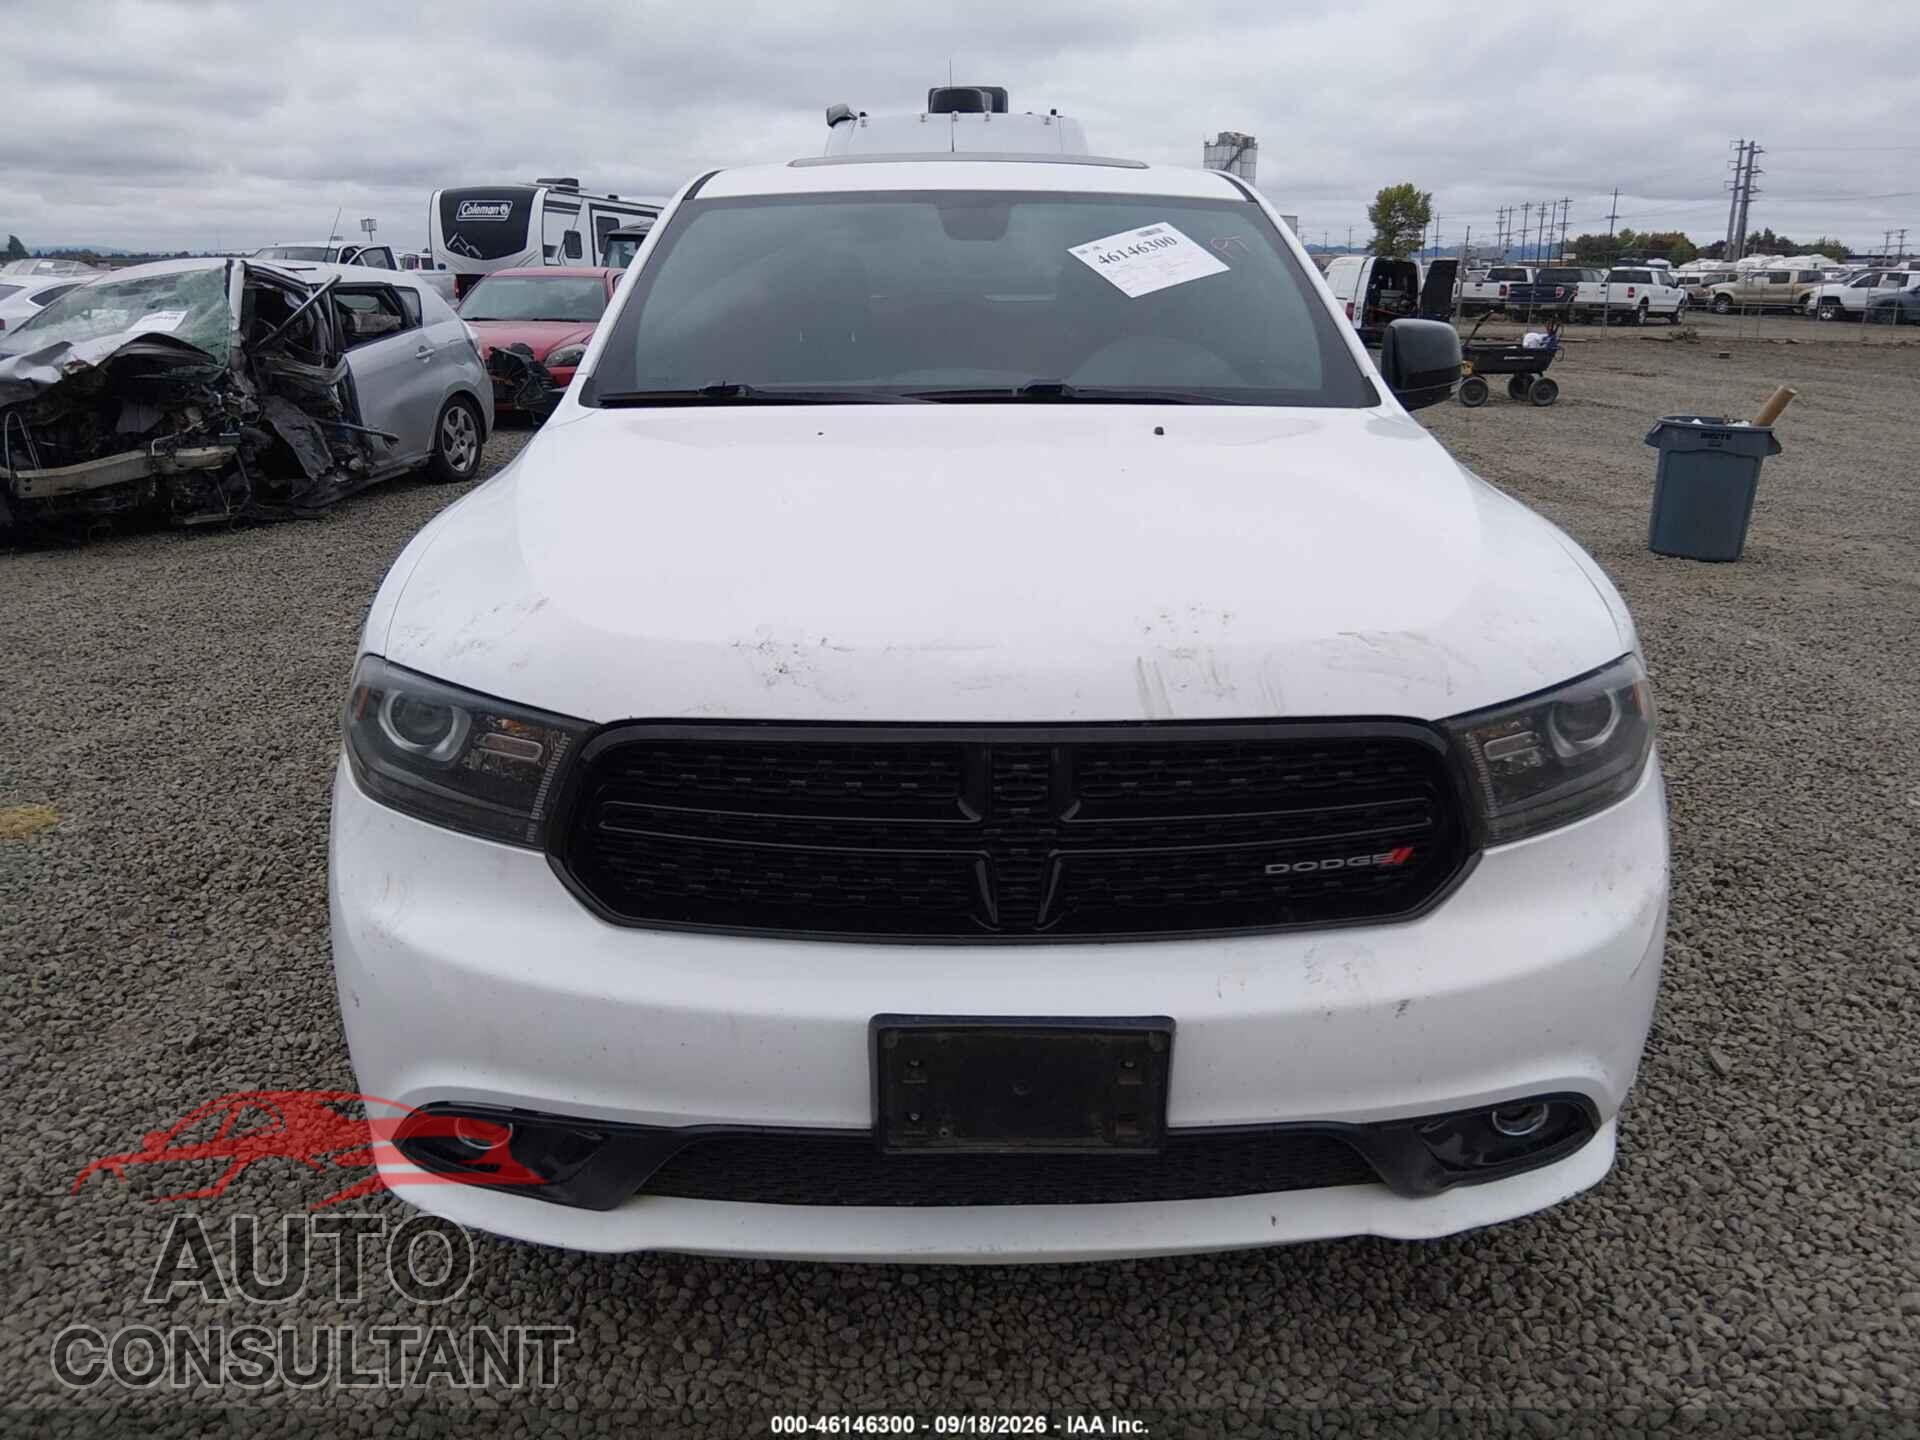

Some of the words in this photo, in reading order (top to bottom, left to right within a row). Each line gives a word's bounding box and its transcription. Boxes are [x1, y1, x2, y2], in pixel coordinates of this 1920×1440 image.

[461, 203, 500, 215] Coleman
[1098, 235, 1178, 265] 46146300
[1265, 852, 1394, 874] DODGE
